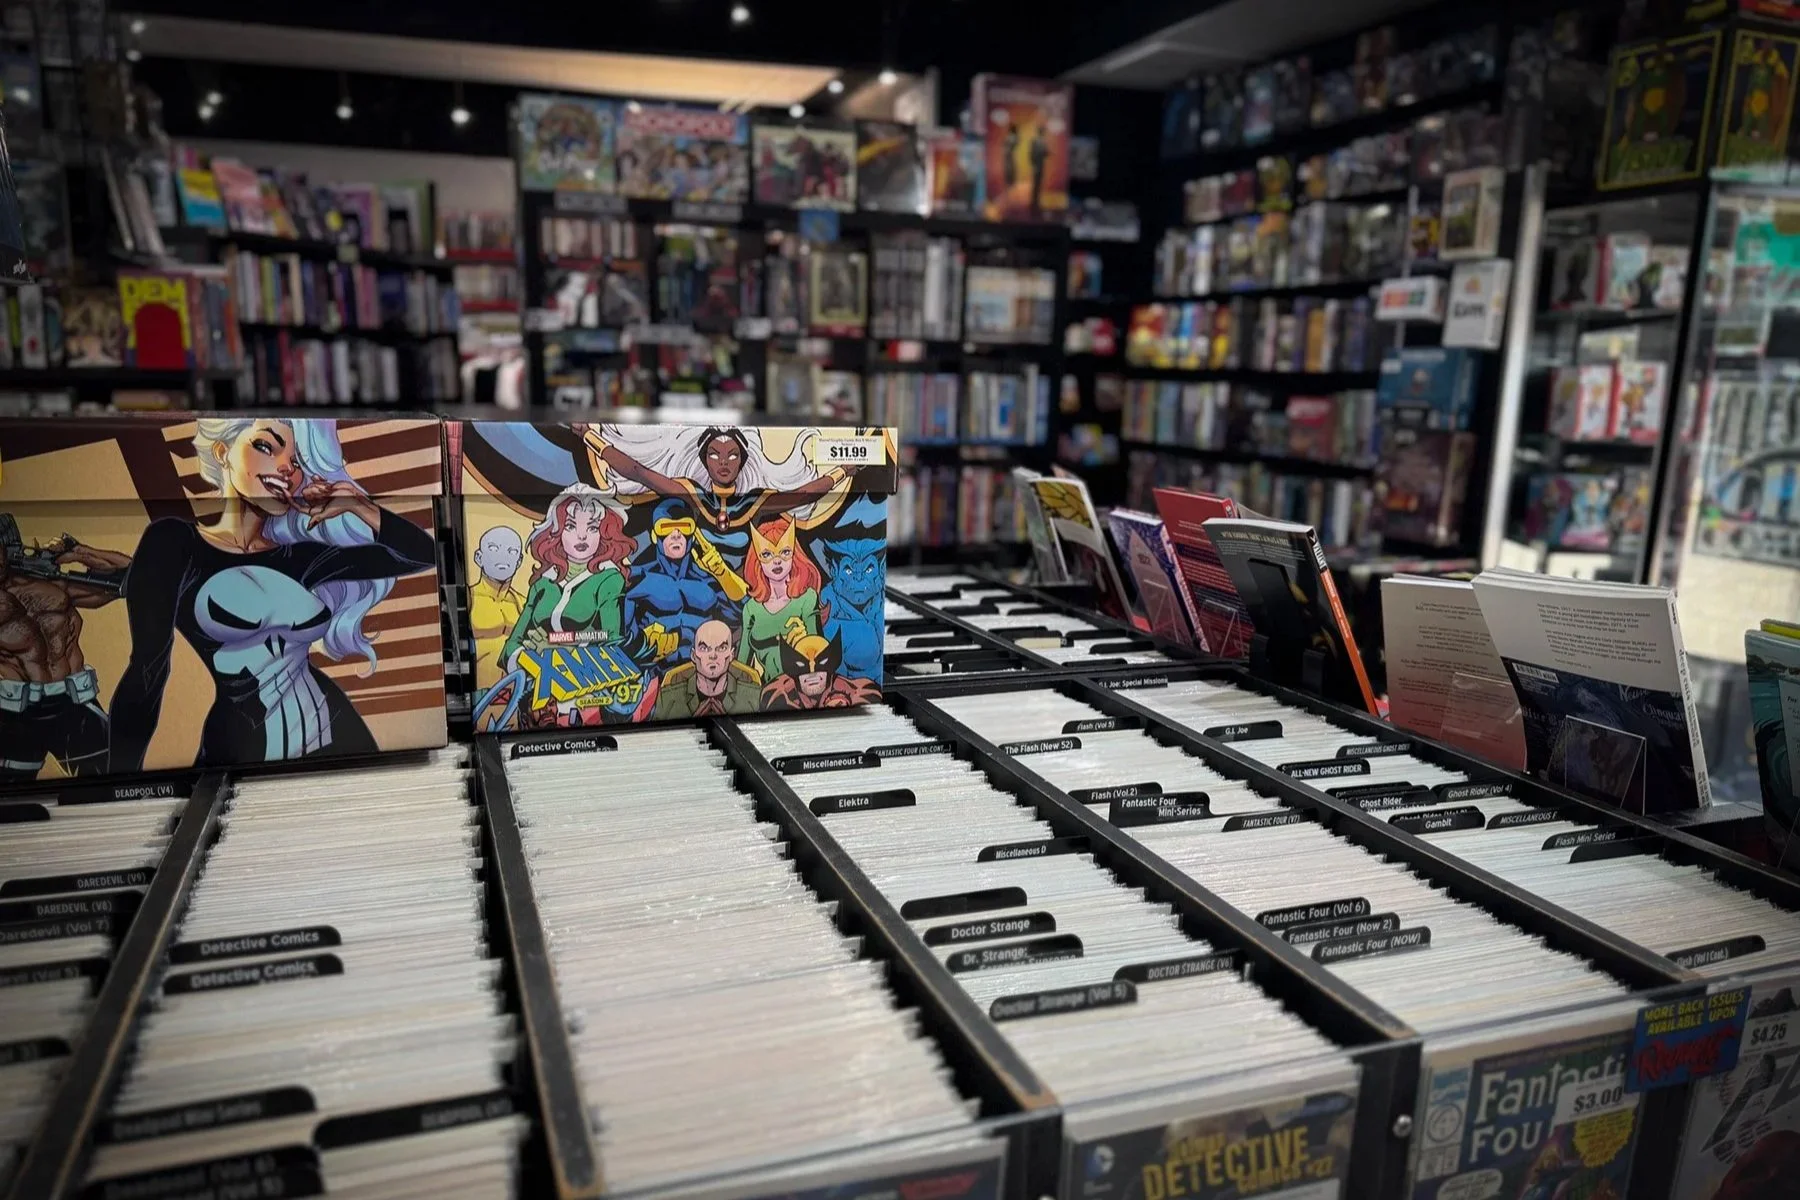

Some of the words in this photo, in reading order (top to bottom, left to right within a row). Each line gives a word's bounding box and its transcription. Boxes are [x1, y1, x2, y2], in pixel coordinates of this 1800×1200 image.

[830, 446, 867, 458] $11.99
[550, 632, 573, 642] MARVEL
[575, 630, 608, 641] ANIMATION
[518, 645, 643, 711] X-MEN
[1122, 678, 1142, 688] Special
[579, 698, 603, 706] SEASON
[1077, 721, 1094, 731] Flash
[1237, 726, 1249, 735] Joe
[518, 741, 562, 755] Detective
[564, 738, 596, 750] Comics
[1005, 745, 1019, 755] The
[1020, 743, 1039, 753] Flash
[1040, 741, 1060, 752] (New
[1061, 740, 1074, 750] 52)
[1346, 745, 1382, 756] MISCELLANEOUS
[1382, 744, 1397, 753] GHOST
[803, 757, 856, 770] Miscellaneous
[858, 755, 864, 765] E
[1291, 767, 1319, 779] ALL-NEW
[1320, 765, 1342, 776] GHOST
[1343, 763, 1363, 774] RIDER
[115, 787, 156, 799] DEADPOOL
[157, 785, 174, 797] (V4)
[1091, 790, 1111, 801] Flash
[1447, 787, 1469, 799] Ghost
[1470, 786, 1489, 797] Rider
[1490, 785, 1503, 797] (Vol
[1504, 783, 1513, 795] 4)
[838, 797, 869, 808] Elektra
[1122, 797, 1157, 808] Fantastic
[1158, 796, 1177, 806] Four
[1360, 797, 1382, 808] Ghost
[1383, 796, 1402, 806] Rider
[1158, 805, 1201, 818] Mini-Series
[1500, 811, 1550, 825] MISCELLANEOUS
[1243, 816, 1272, 828] FANTASTIC
[1273, 815, 1287, 826] FOUR
[1425, 817, 1452, 830] Gambit
[1555, 835, 1575, 847] Flash
[1576, 834, 1592, 845] Mini
[1593, 831, 1616, 843] Series
[996, 847, 1039, 860] Miscellaneous
[1040, 845, 1047, 856] D
[77, 875, 125, 889] DAREDEVIL
[127, 872, 147, 885] (V9)
[37, 902, 90, 915] DAREDEVIL
[1263, 910, 1306, 926] Fantastic
[1308, 906, 1330, 919] Four
[1333, 903, 1350, 918] (Vol
[1354, 902, 1366, 914] 6)
[66, 918, 92, 936] (Vol
[951, 924, 987, 939] Doctor
[989, 917, 1031, 935] Strange
[1289, 929, 1330, 945] Fantastic
[1332, 925, 1354, 938] Four
[1355, 921, 1381, 937] (Now
[1382, 919, 1393, 932] 2)
[201, 935, 268, 956] Detective
[271, 930, 320, 946] Comics
[1320, 943, 1364, 958] Fantastic
[1365, 937, 1388, 951] Four
[1390, 932, 1421, 948] (NOW)
[963, 953, 979, 966] Dr.
[982, 946, 1028, 962] Strange:
[190, 966, 261, 989] Detective
[263, 960, 316, 979] Comics
[1148, 965, 1180, 980] DOCTOR
[1181, 960, 1215, 977] STRANGE
[1216, 956, 1234, 973] (V6)
[993, 998, 1036, 1016] Doctor
[1038, 991, 1085, 1012] Strange
[1645, 1004, 1675, 1024] MORE
[1678, 999, 1705, 1017] BACK
[1708, 989, 1745, 1008] ISSUES
[1647, 1013, 1704, 1036] AVAILABLE
[1708, 1006, 1737, 1024] UPON
[1751, 1022, 1787, 1046] $4.25
[1574, 1086, 1623, 1113] $3.00
[1142, 1126, 1311, 1200] DETECTIVE
